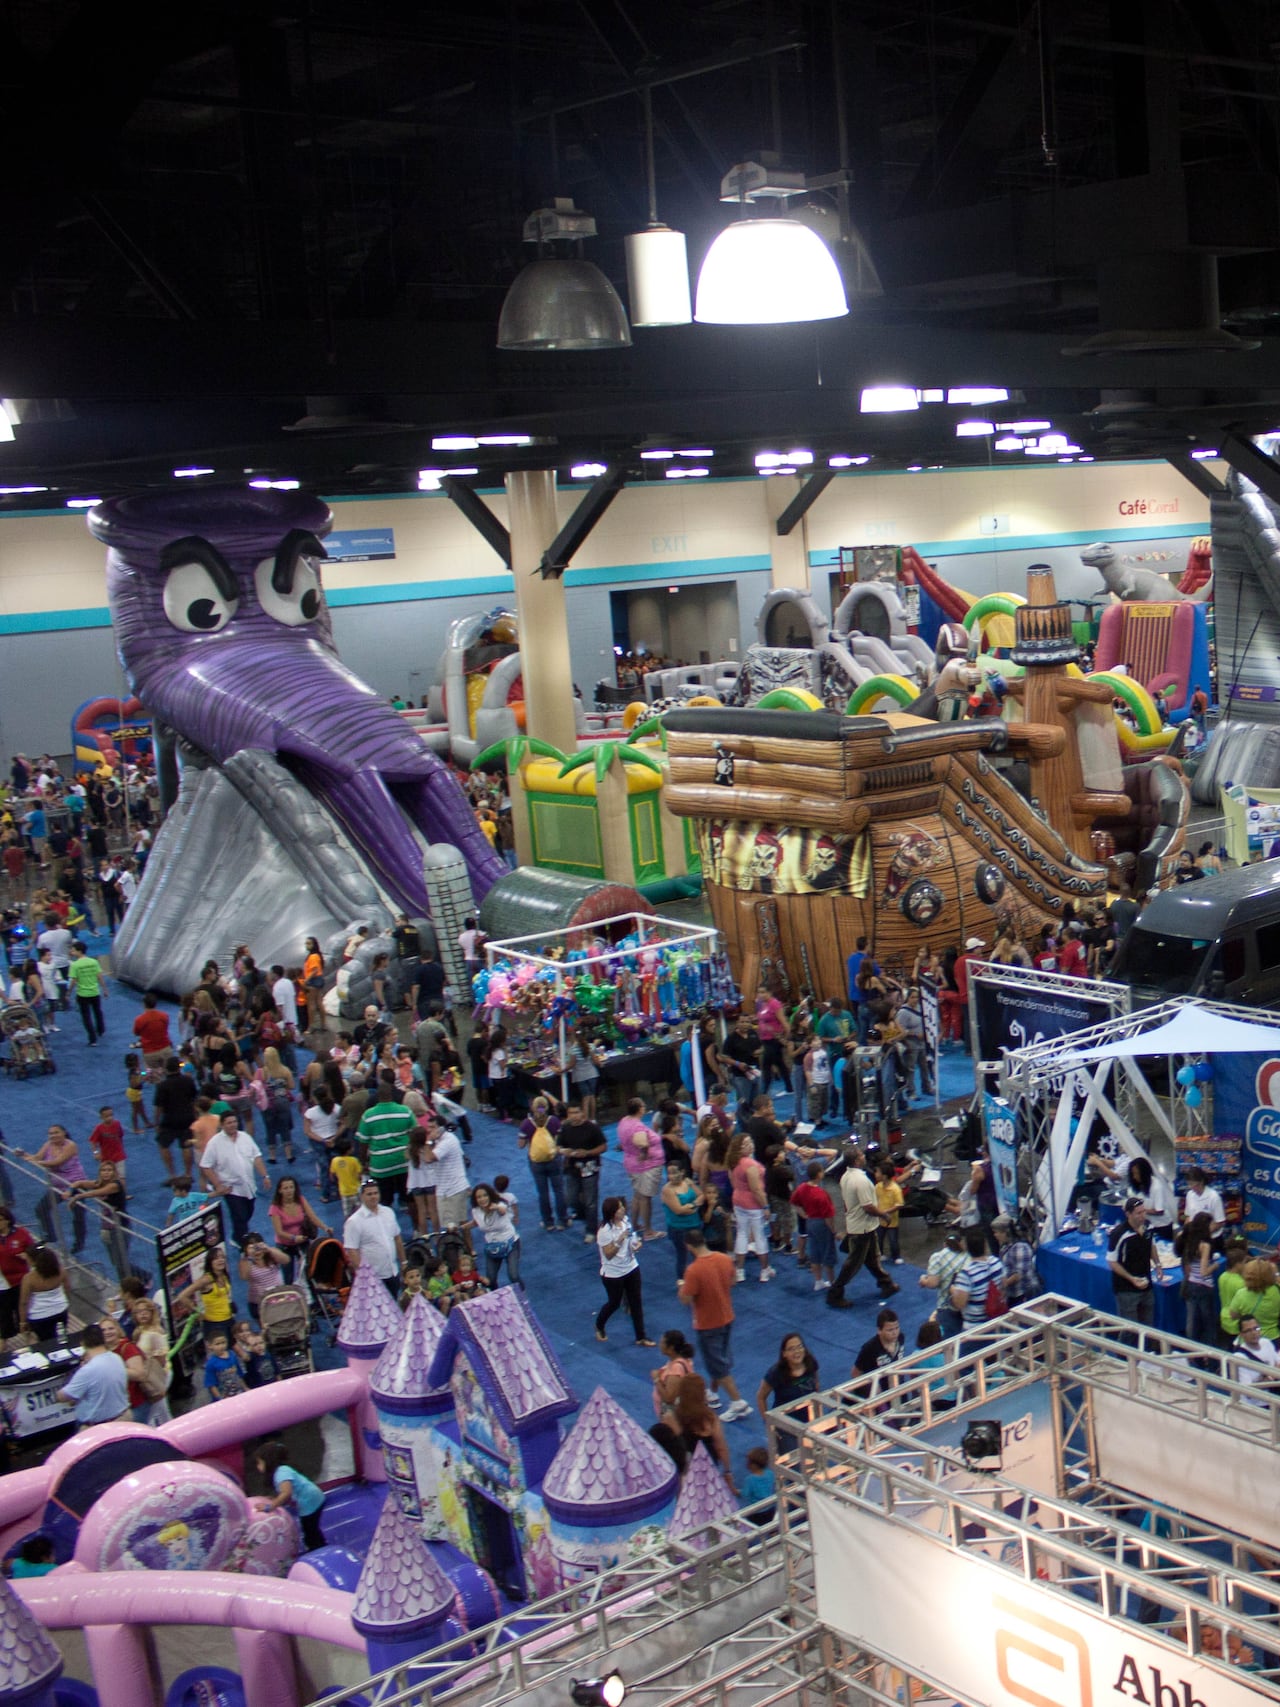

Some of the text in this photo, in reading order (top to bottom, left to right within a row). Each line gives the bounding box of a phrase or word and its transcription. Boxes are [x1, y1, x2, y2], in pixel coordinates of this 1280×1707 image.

[1119, 497, 1179, 515] Café Coral
[651, 534, 689, 554] EXIT
[996, 992, 1090, 1021] thewondermachine.com
[1253, 1168, 1271, 1182] es
